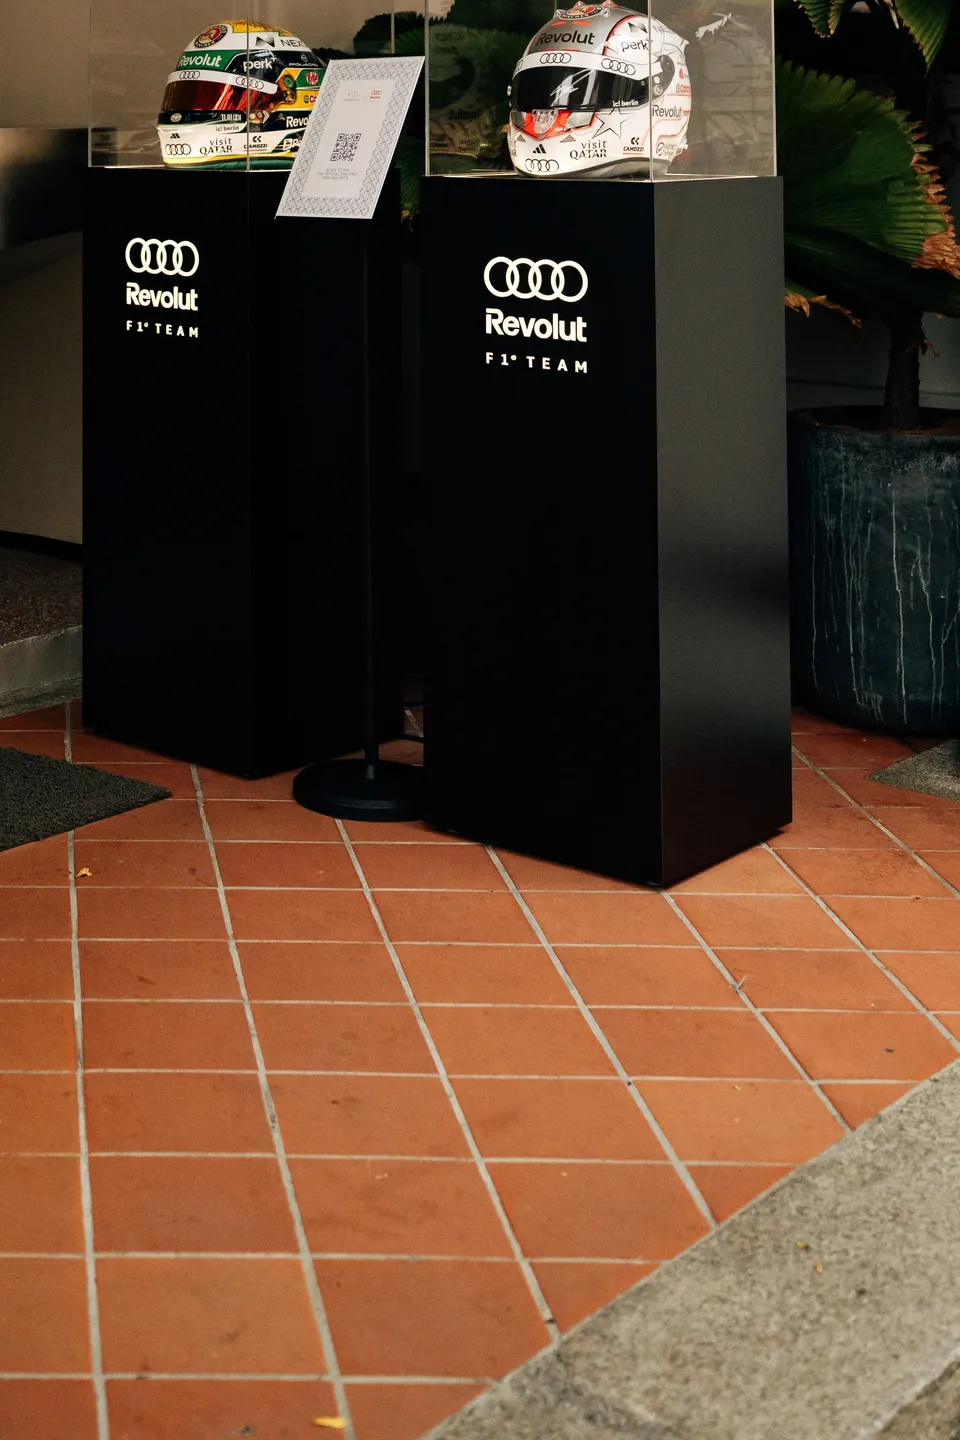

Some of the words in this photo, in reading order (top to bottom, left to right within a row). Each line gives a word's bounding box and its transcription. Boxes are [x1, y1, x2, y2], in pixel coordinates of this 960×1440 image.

[536, 30, 596, 47] Revolut
[178, 53, 222, 68] Revolut
[652, 104, 682, 118] Revolut
[223, 125, 240, 133] berlin
[286, 115, 309, 129] Revo
[209, 136, 232, 147] visit
[580, 139, 607, 150] visit
[199, 145, 233, 156] QATAR
[569, 148, 607, 160] QATAR
[126, 282, 198, 311] Revolut
[155, 323, 199, 338] TEAM
[485, 307, 587, 342] Revolut
[526, 356, 588, 373] TEAM
